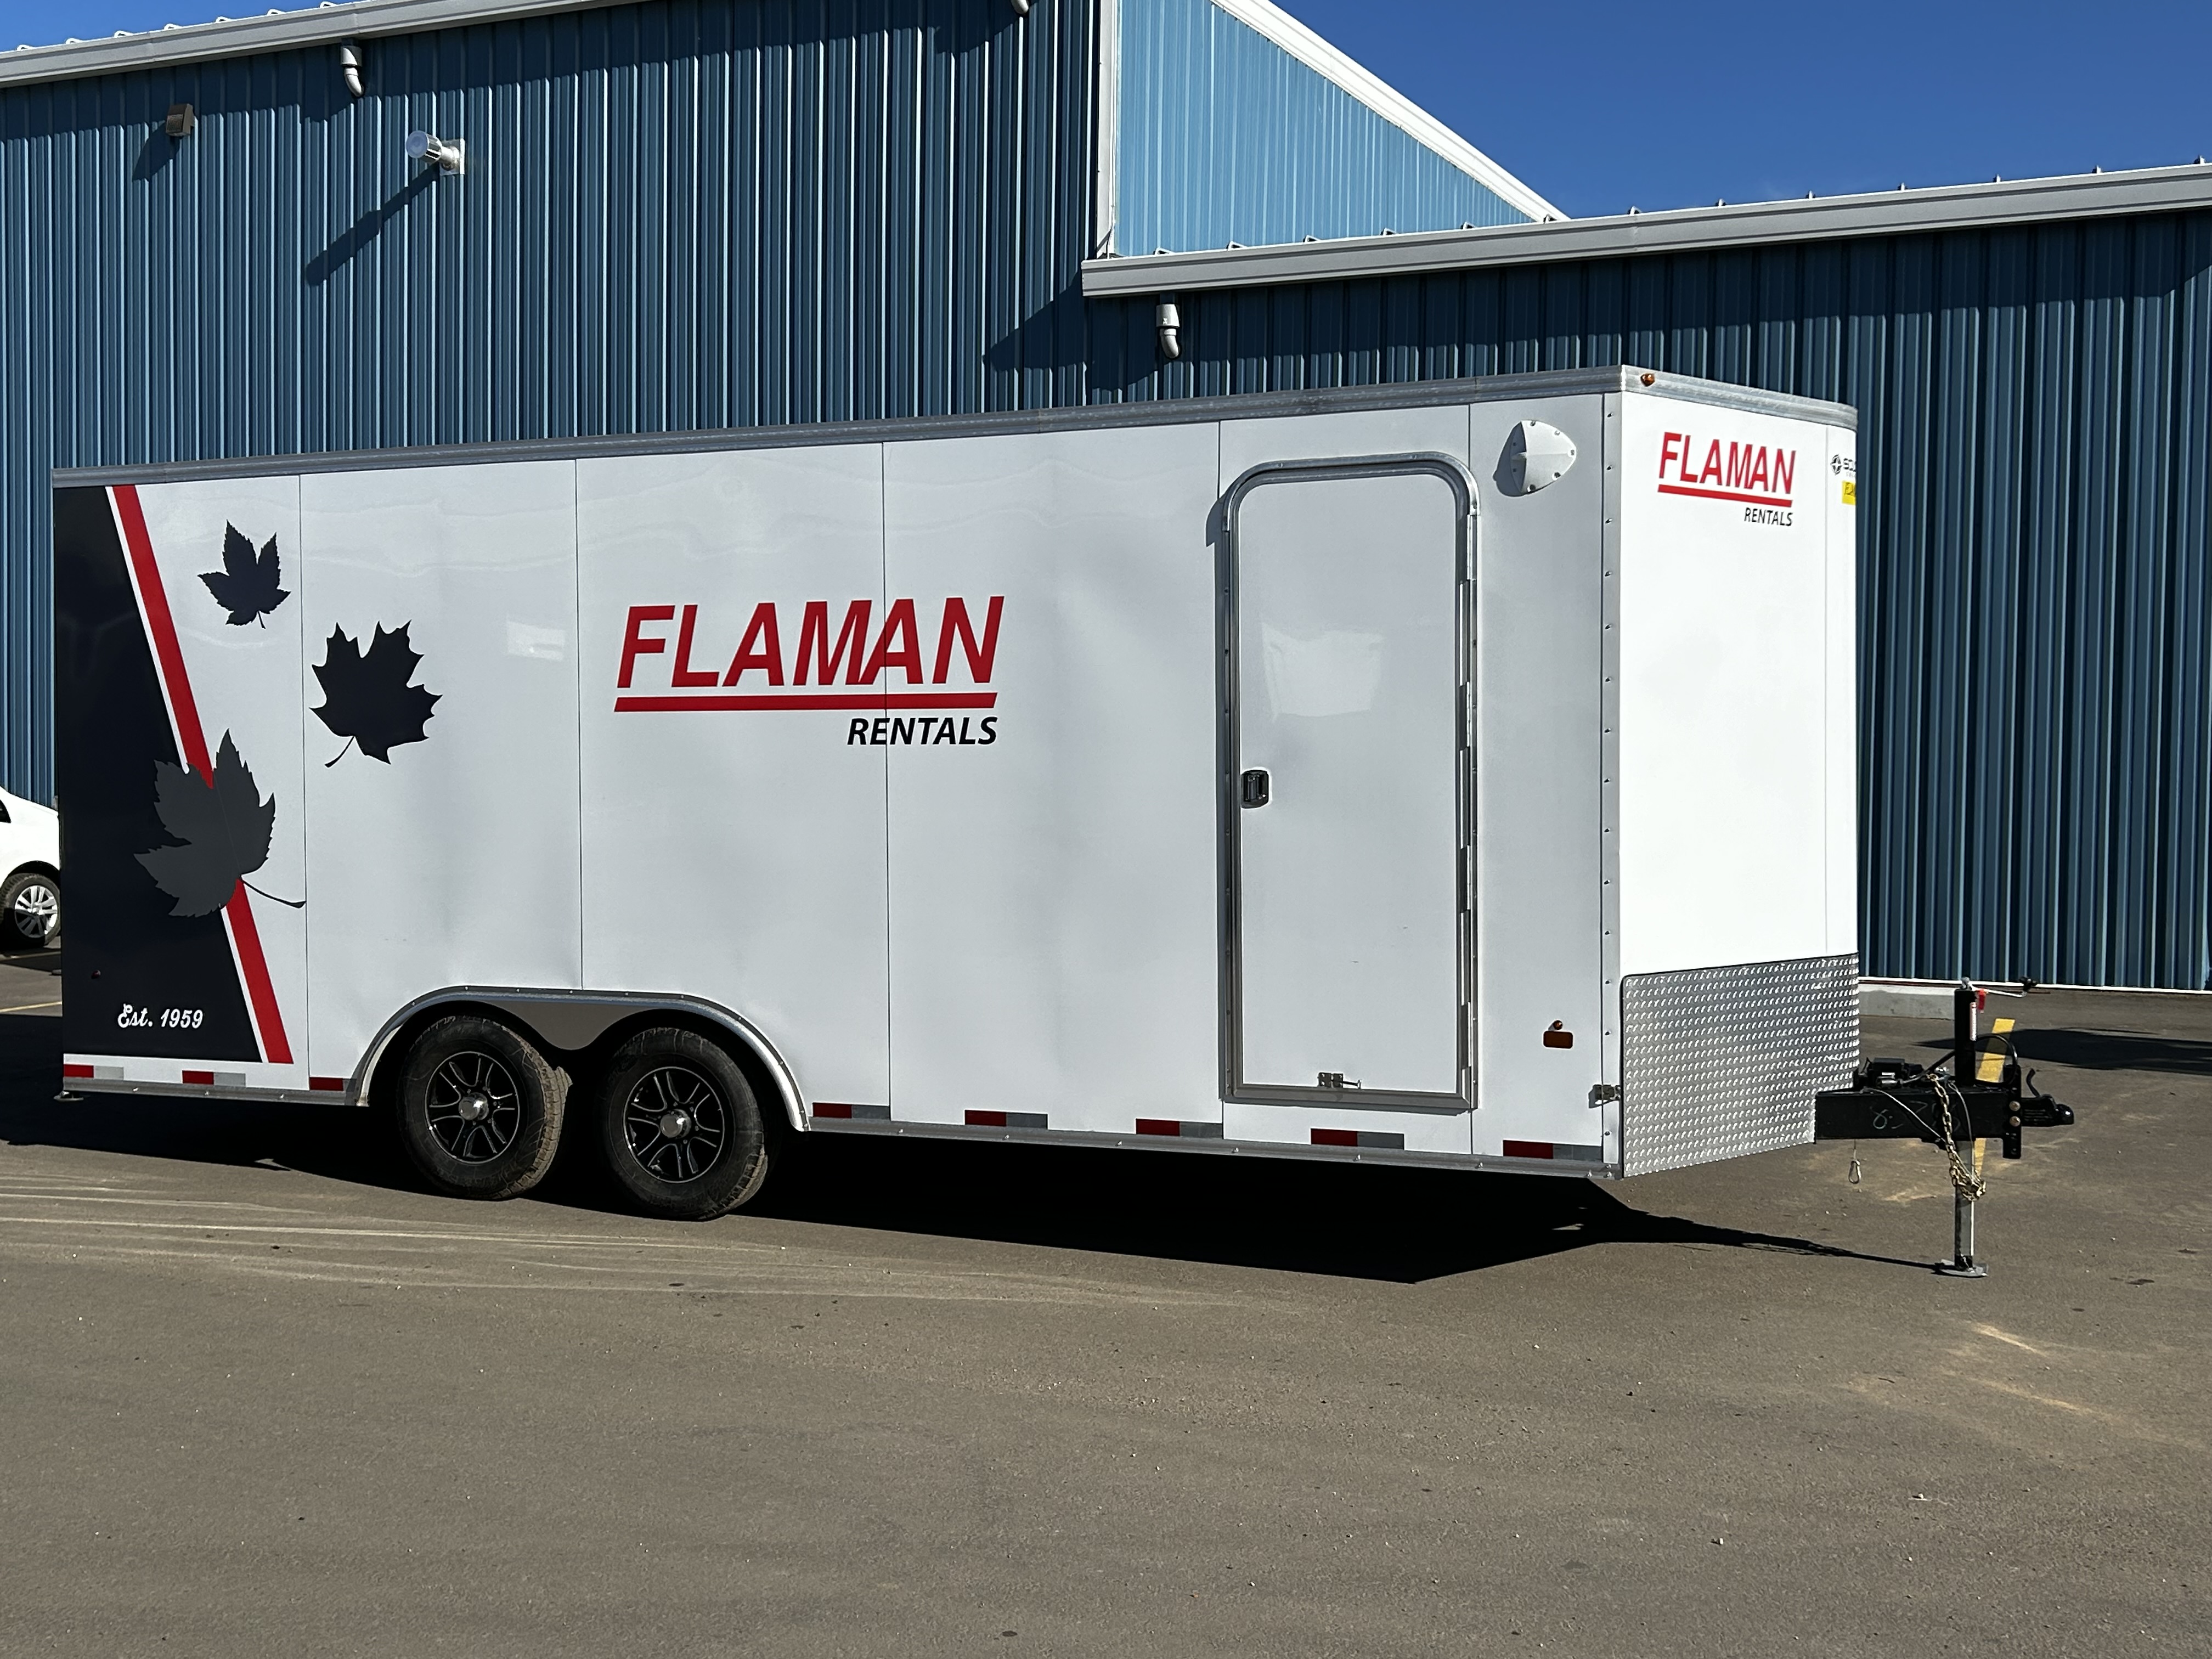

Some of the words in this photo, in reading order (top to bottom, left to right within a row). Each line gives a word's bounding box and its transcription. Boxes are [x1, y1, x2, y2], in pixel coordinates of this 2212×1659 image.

[1658, 431, 1797, 494] FLAMAN
[1744, 507, 1793, 527] RENTALS
[617, 596, 1005, 688] FLAMAN
[847, 716, 998, 745] RENTALS
[117, 1003, 153, 1028] Est.
[161, 1008, 204, 1029] 1959
